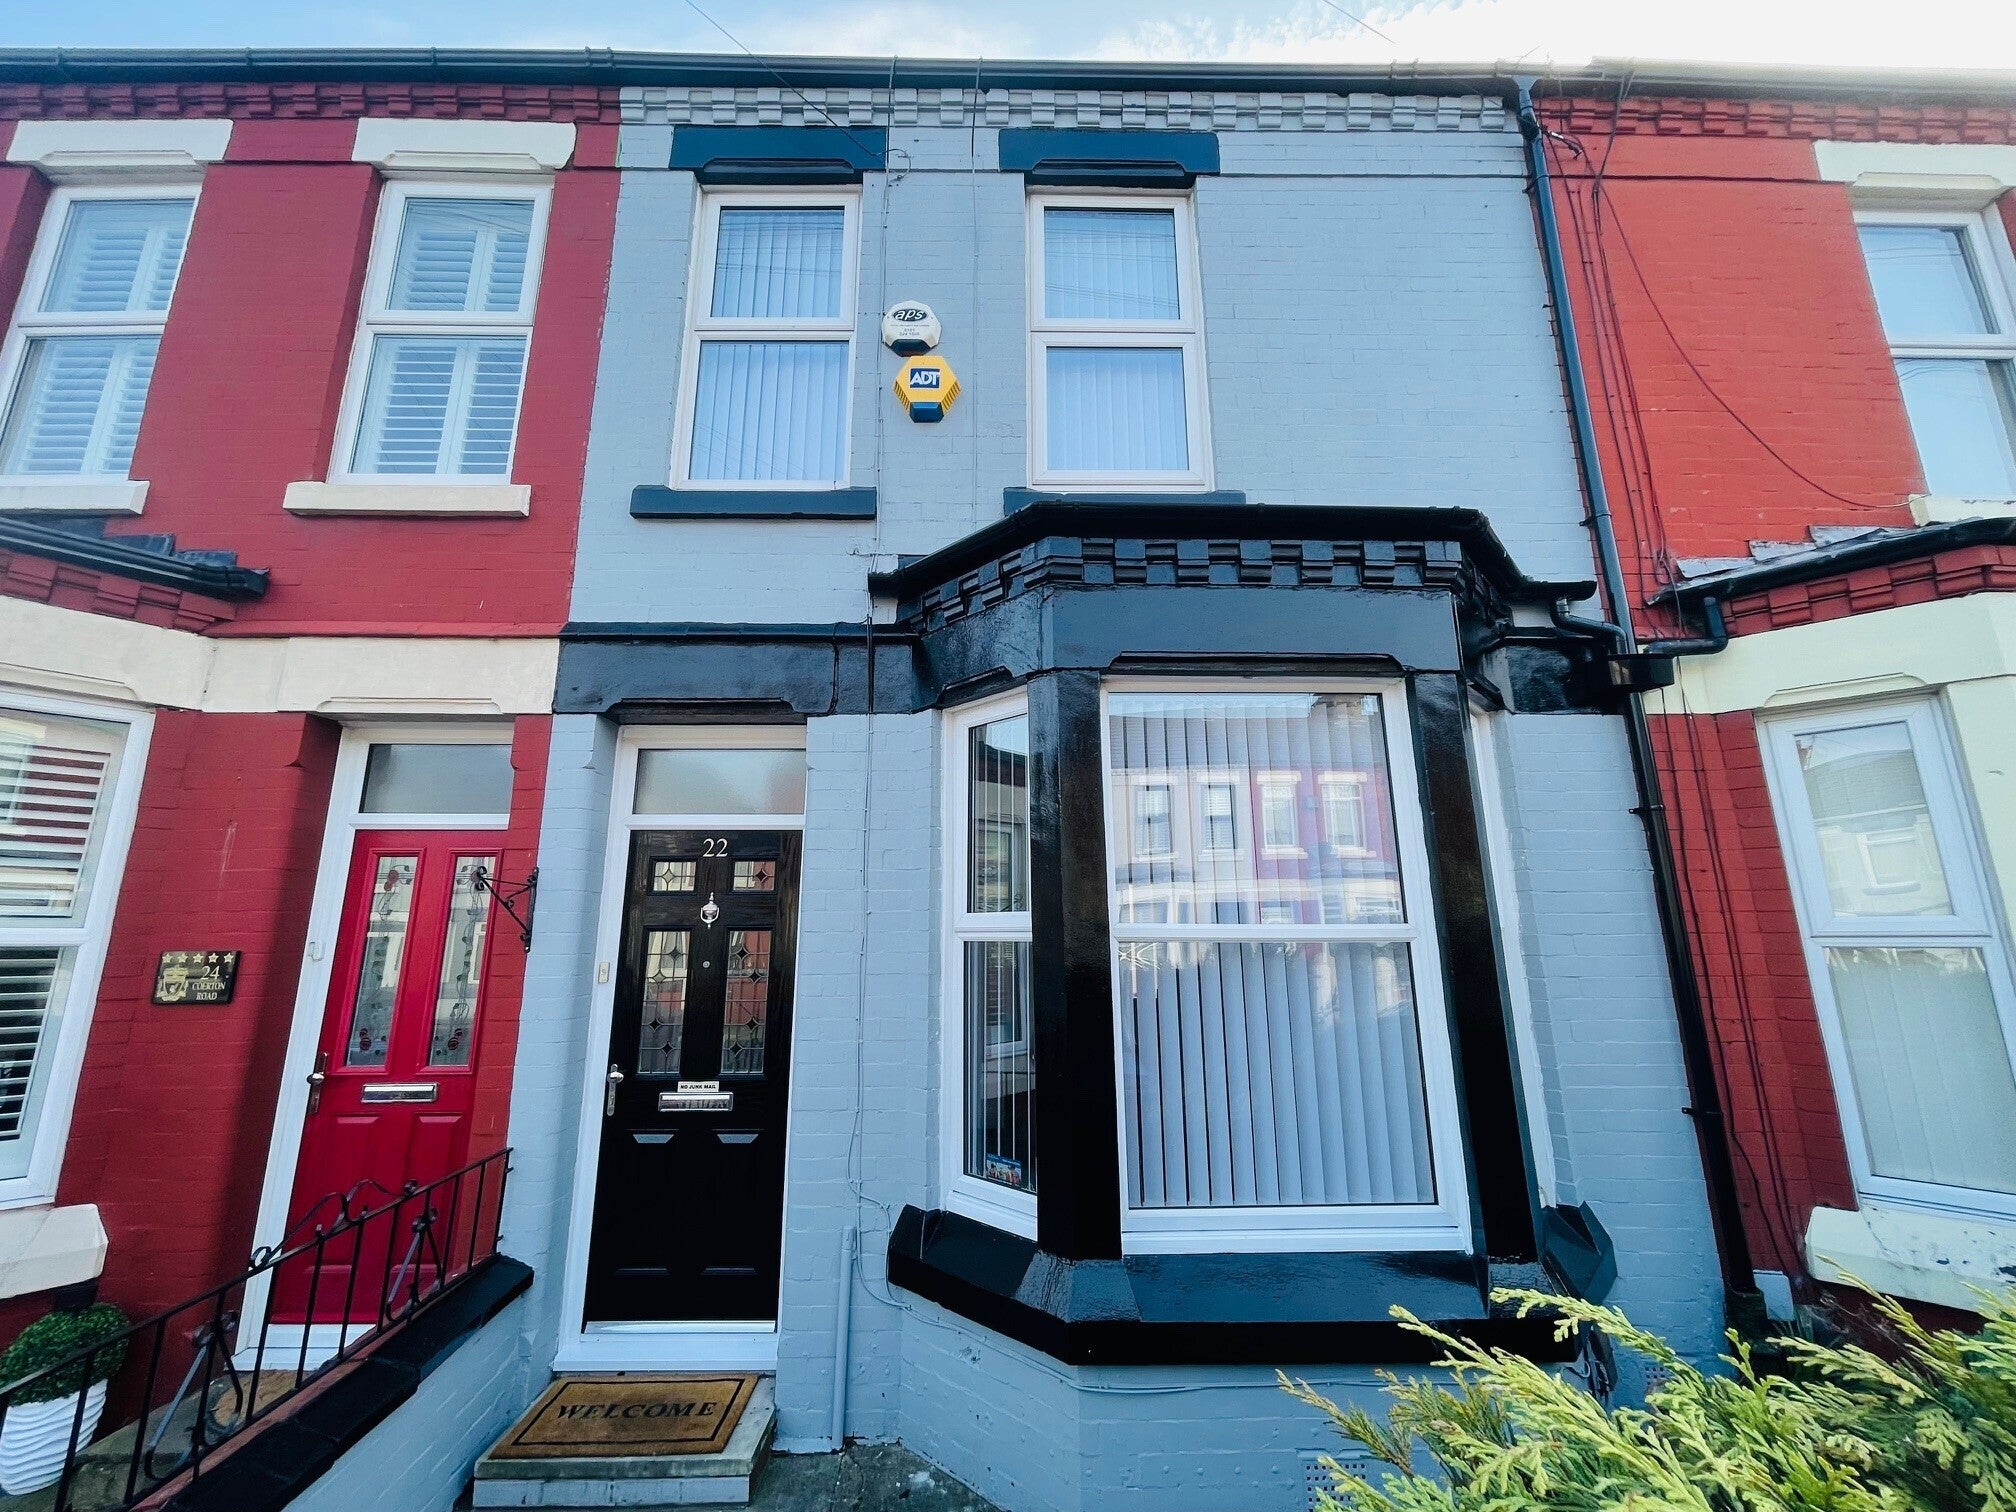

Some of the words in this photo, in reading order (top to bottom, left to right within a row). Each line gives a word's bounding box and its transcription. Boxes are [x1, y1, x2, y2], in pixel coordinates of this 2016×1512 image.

[895, 310, 923, 320] aps
[910, 371, 940, 385] ADT
[703, 838, 728, 857] 22
[201, 965, 220, 980] 24
[196, 992, 218, 1001] ROAD
[557, 1402, 717, 1419] WELCOME
